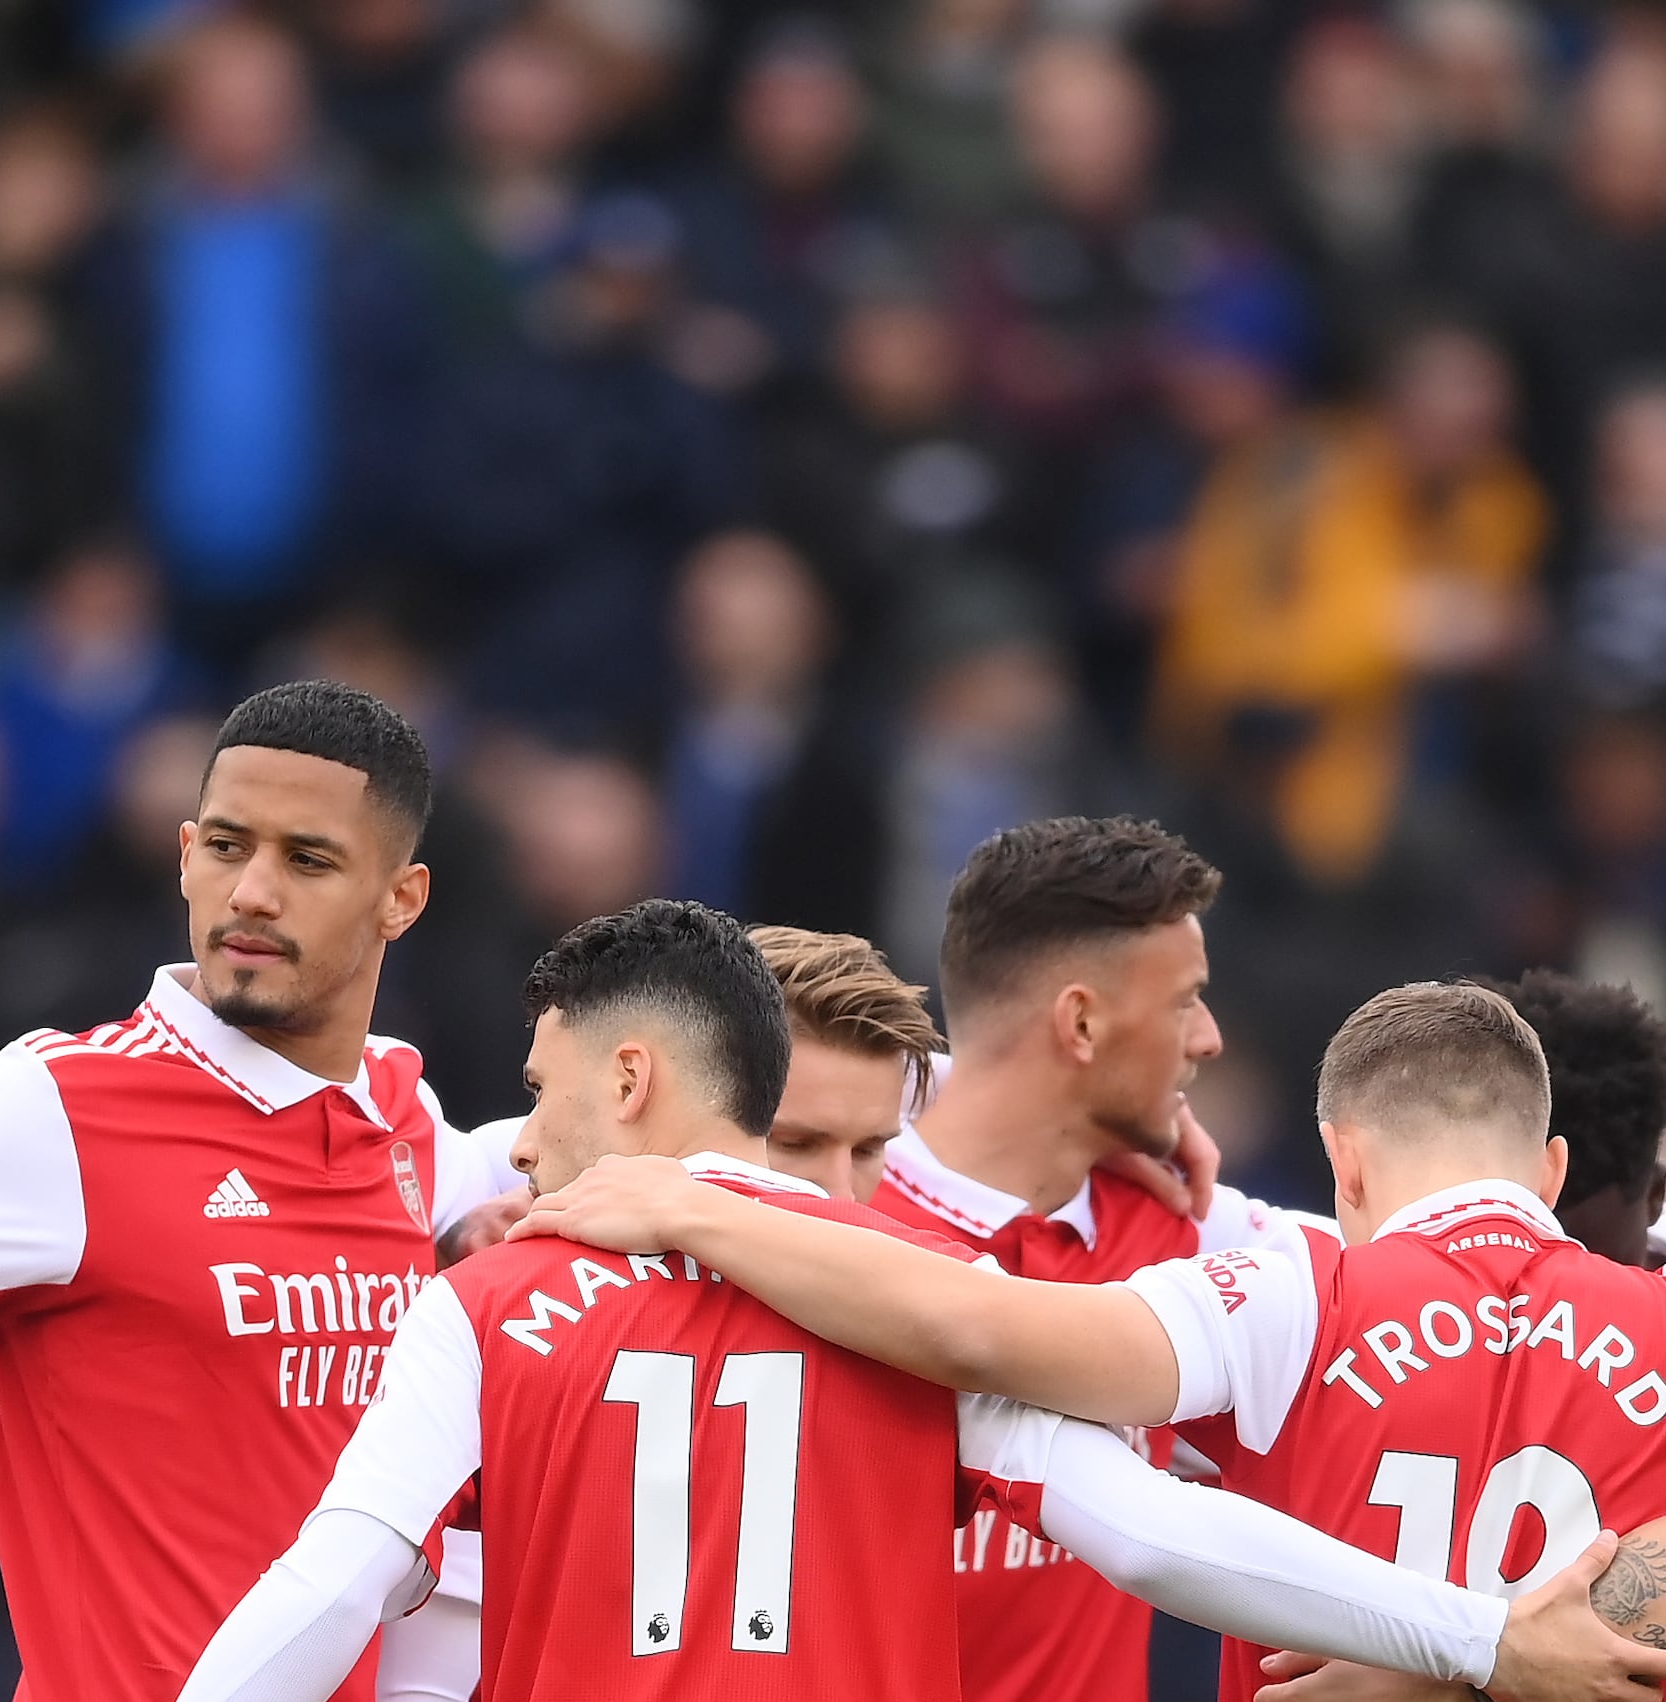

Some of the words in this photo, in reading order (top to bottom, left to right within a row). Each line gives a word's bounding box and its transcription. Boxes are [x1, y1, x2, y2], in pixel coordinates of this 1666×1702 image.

[203, 1200, 271, 1219] adidas
[1446, 1232, 1536, 1254] ARSENAL
[208, 1255, 434, 1337] Emirat
[278, 1345, 337, 1408] FLY
[602, 1348, 804, 1657] 11
[953, 1510, 998, 1574] LY
